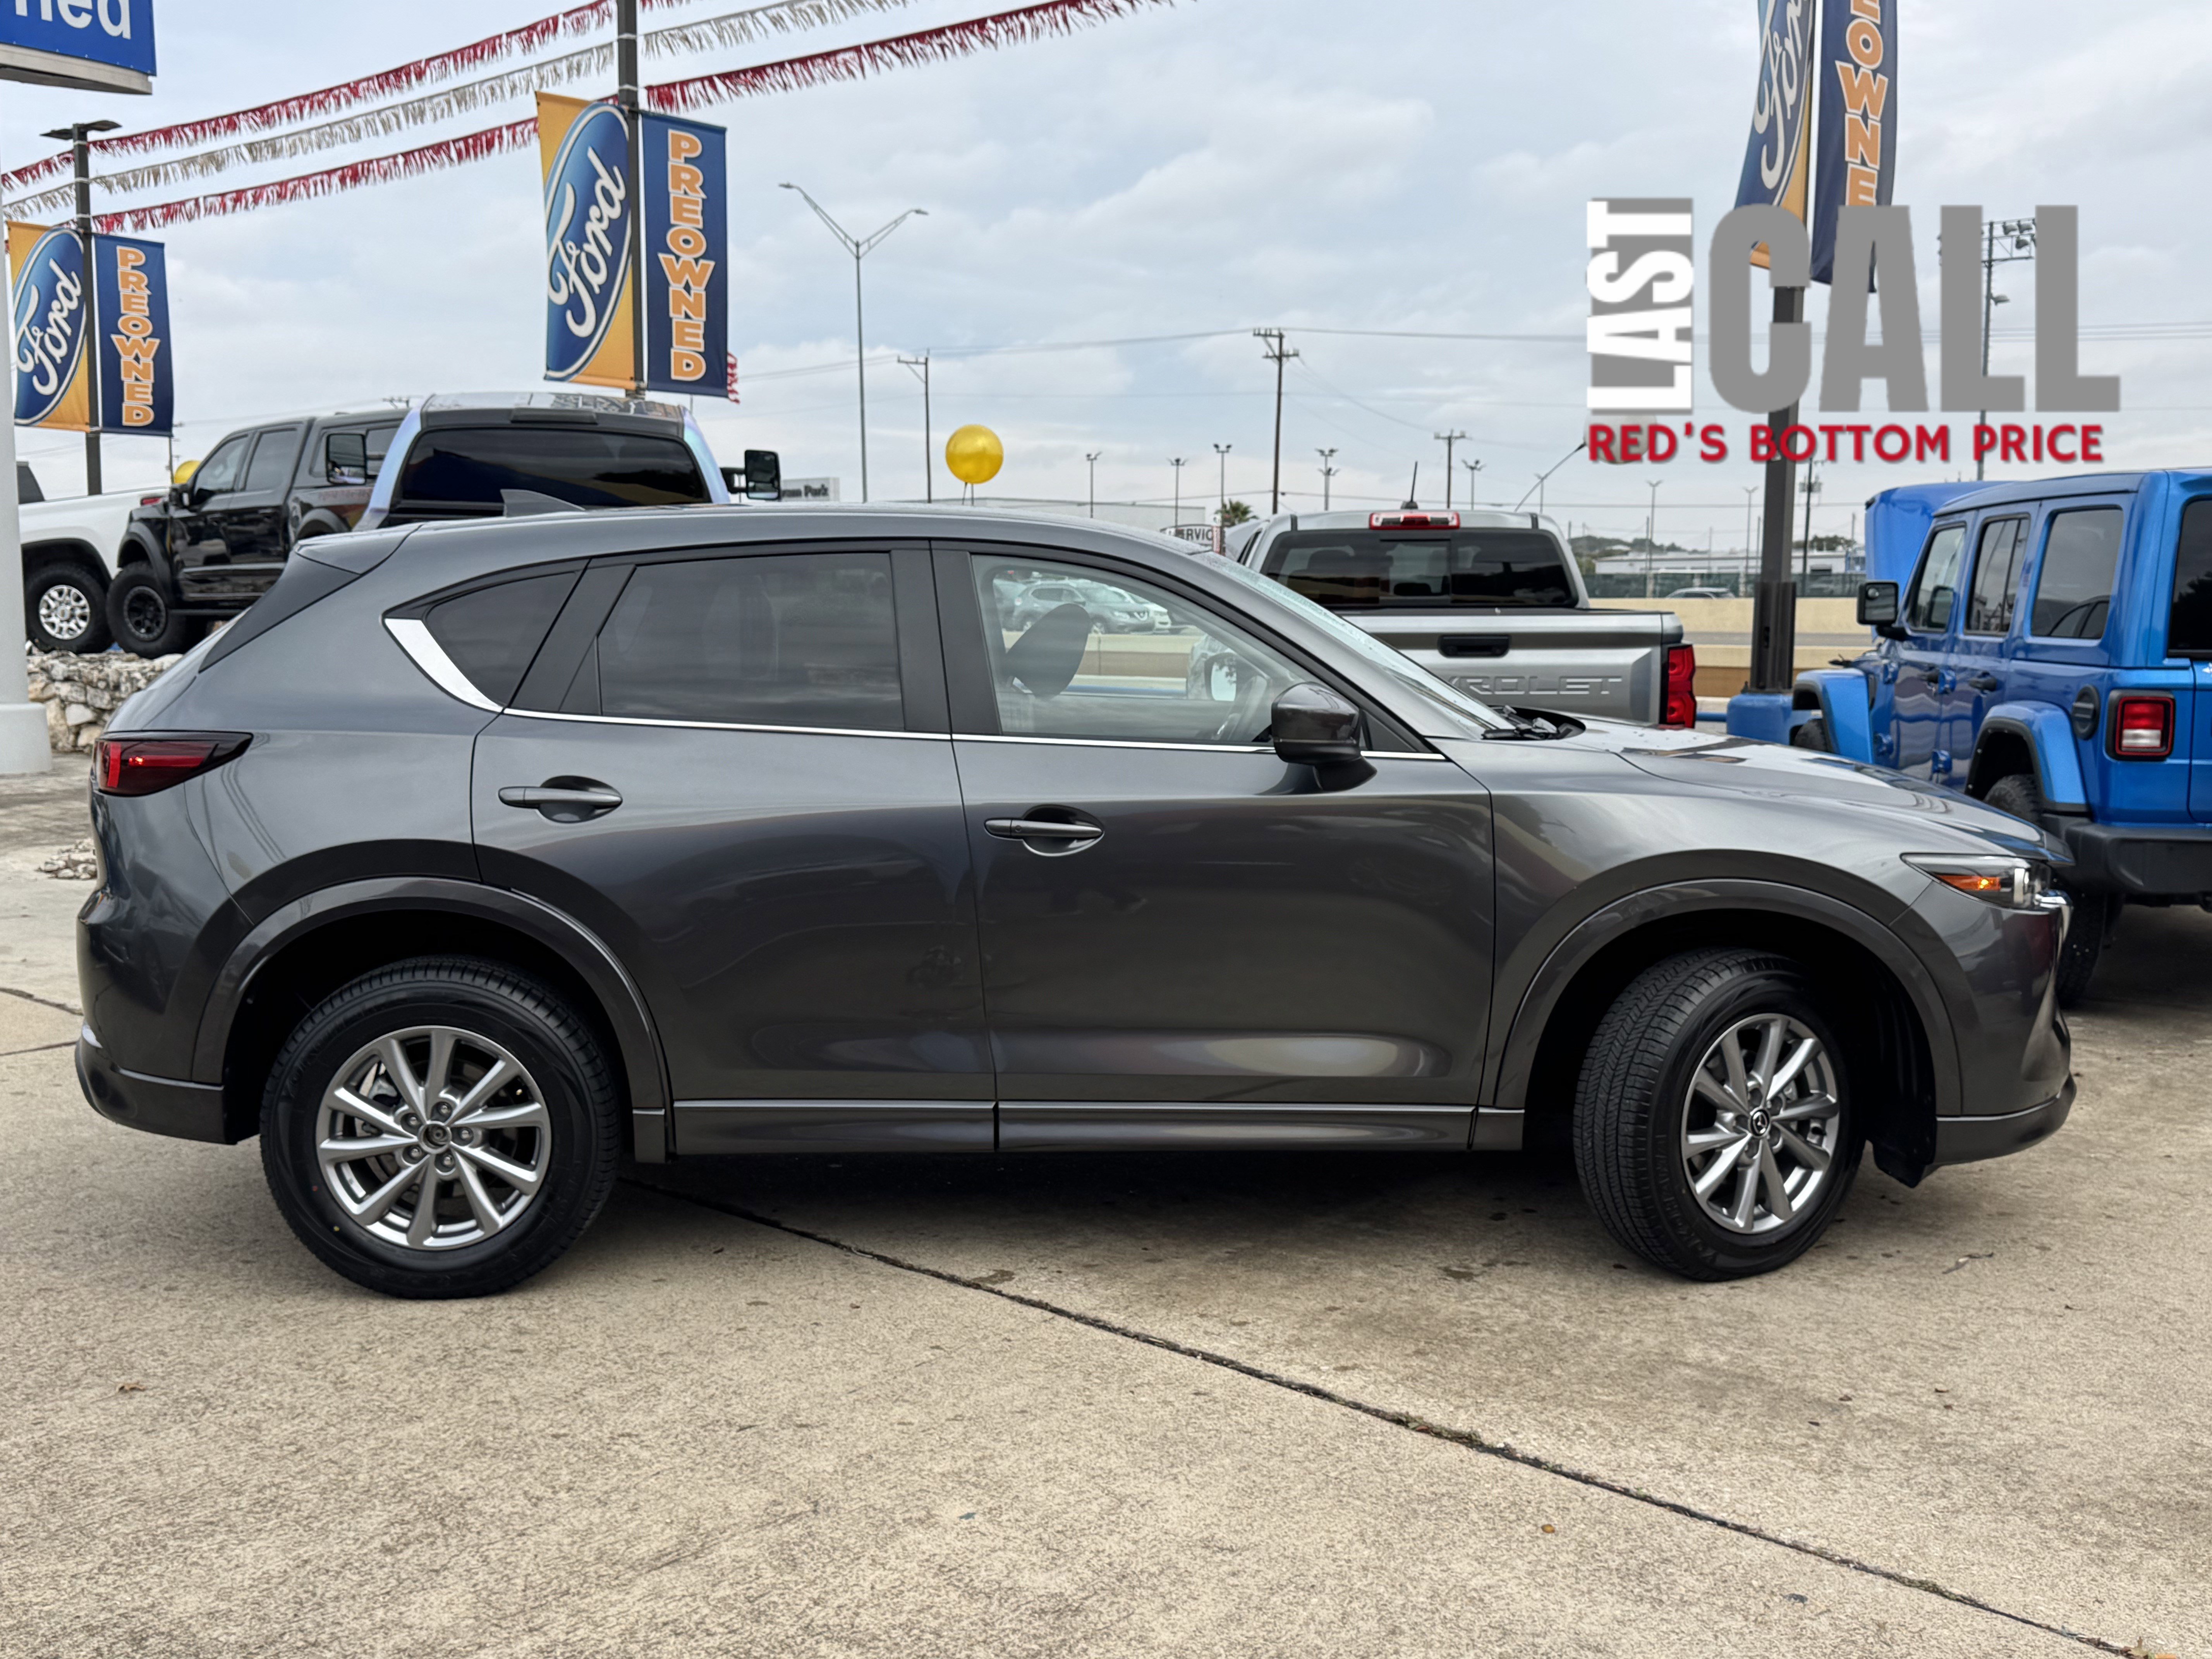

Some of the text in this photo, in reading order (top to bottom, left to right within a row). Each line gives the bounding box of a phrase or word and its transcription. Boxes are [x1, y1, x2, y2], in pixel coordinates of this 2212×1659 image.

[1754, 0, 1802, 189] For
[17, 258, 82, 395] Ford
[547, 146, 626, 337] Ford
[658, 129, 716, 381] PREOWNED
[110, 246, 161, 426] PREOWNED
[1450, 676, 1622, 695] ROLET
